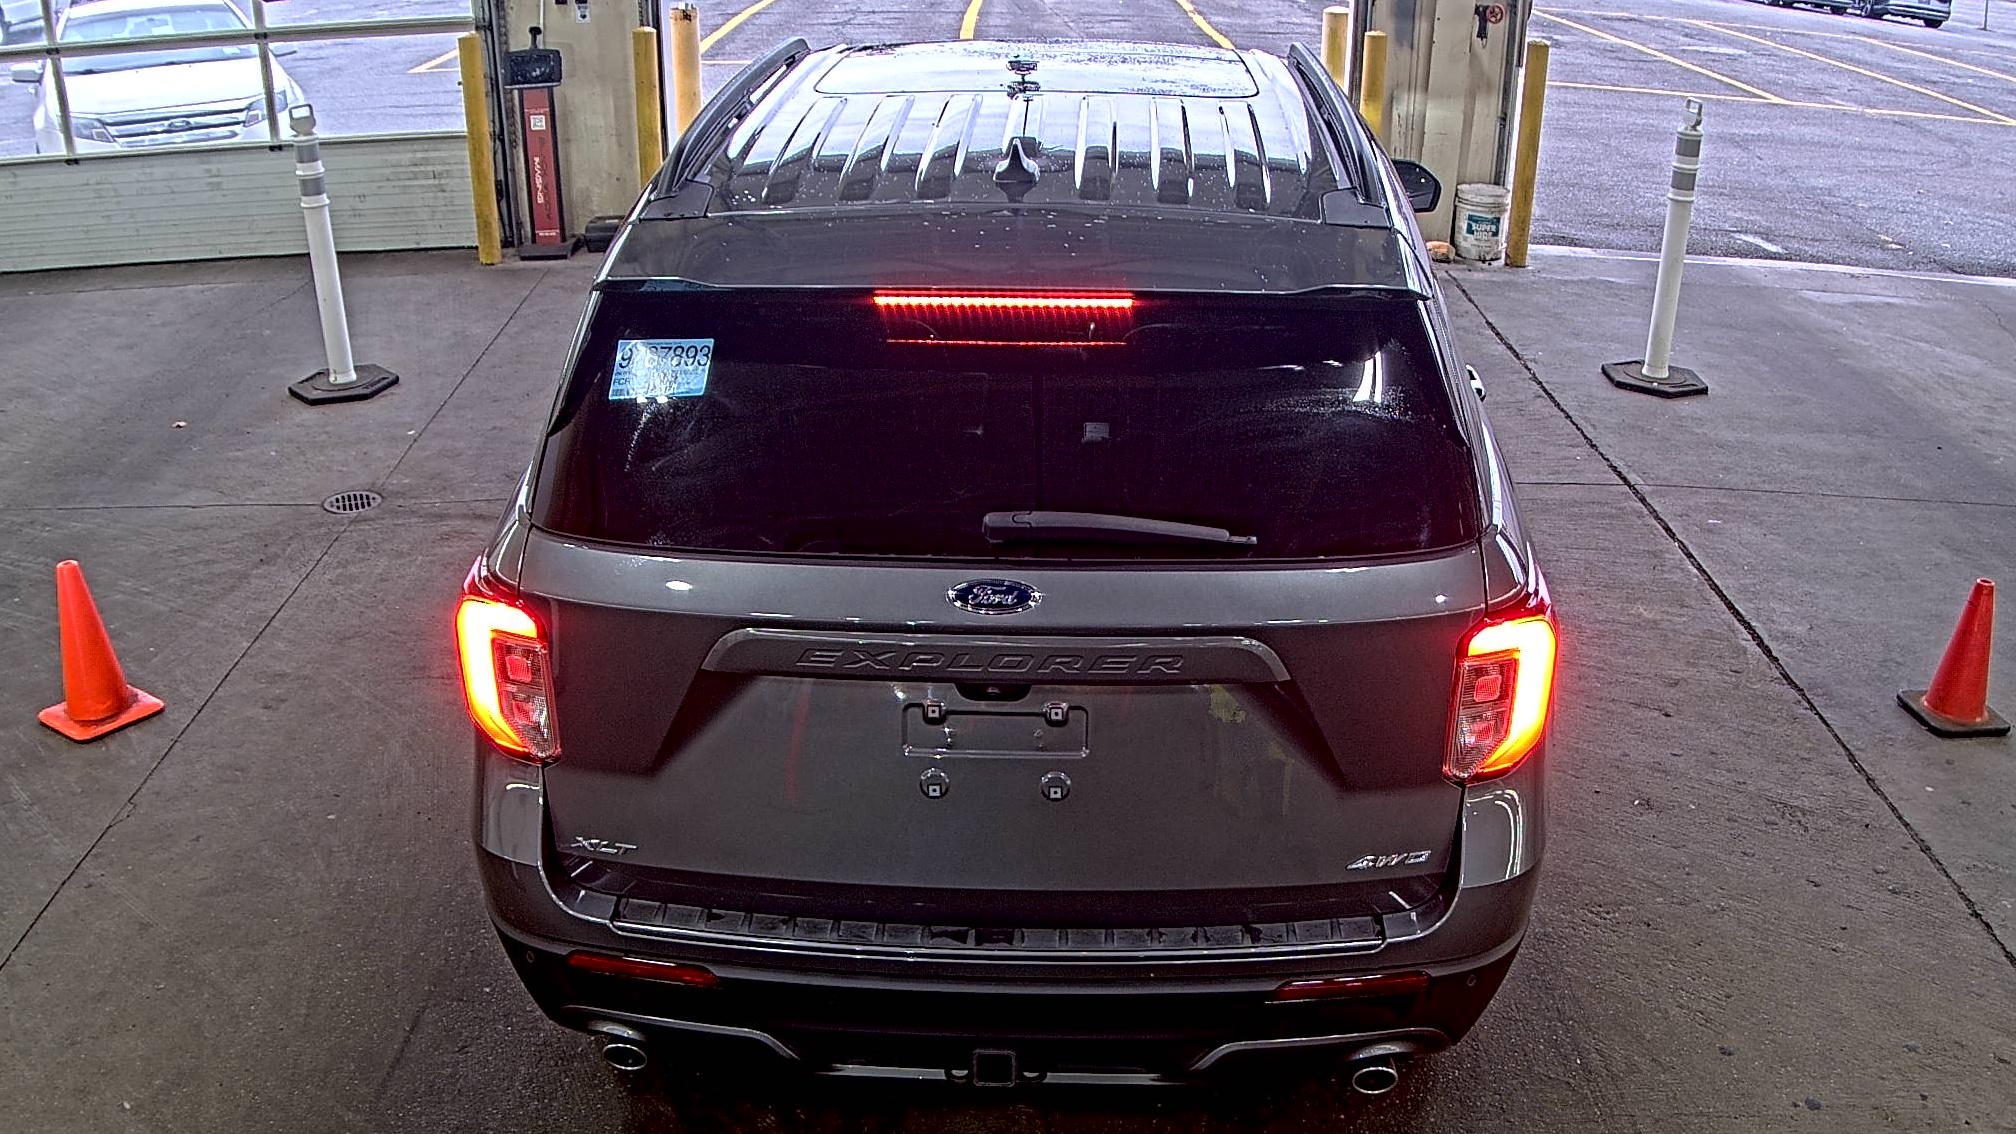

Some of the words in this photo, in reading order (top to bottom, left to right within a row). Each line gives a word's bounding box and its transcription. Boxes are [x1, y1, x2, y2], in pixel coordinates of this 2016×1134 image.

[619, 344, 711, 369] 97893
[968, 585, 1019, 605] Ford
[796, 648, 1184, 674] EXPLORER
[571, 836, 637, 855] XLT
[1346, 850, 1431, 869] 4WD
